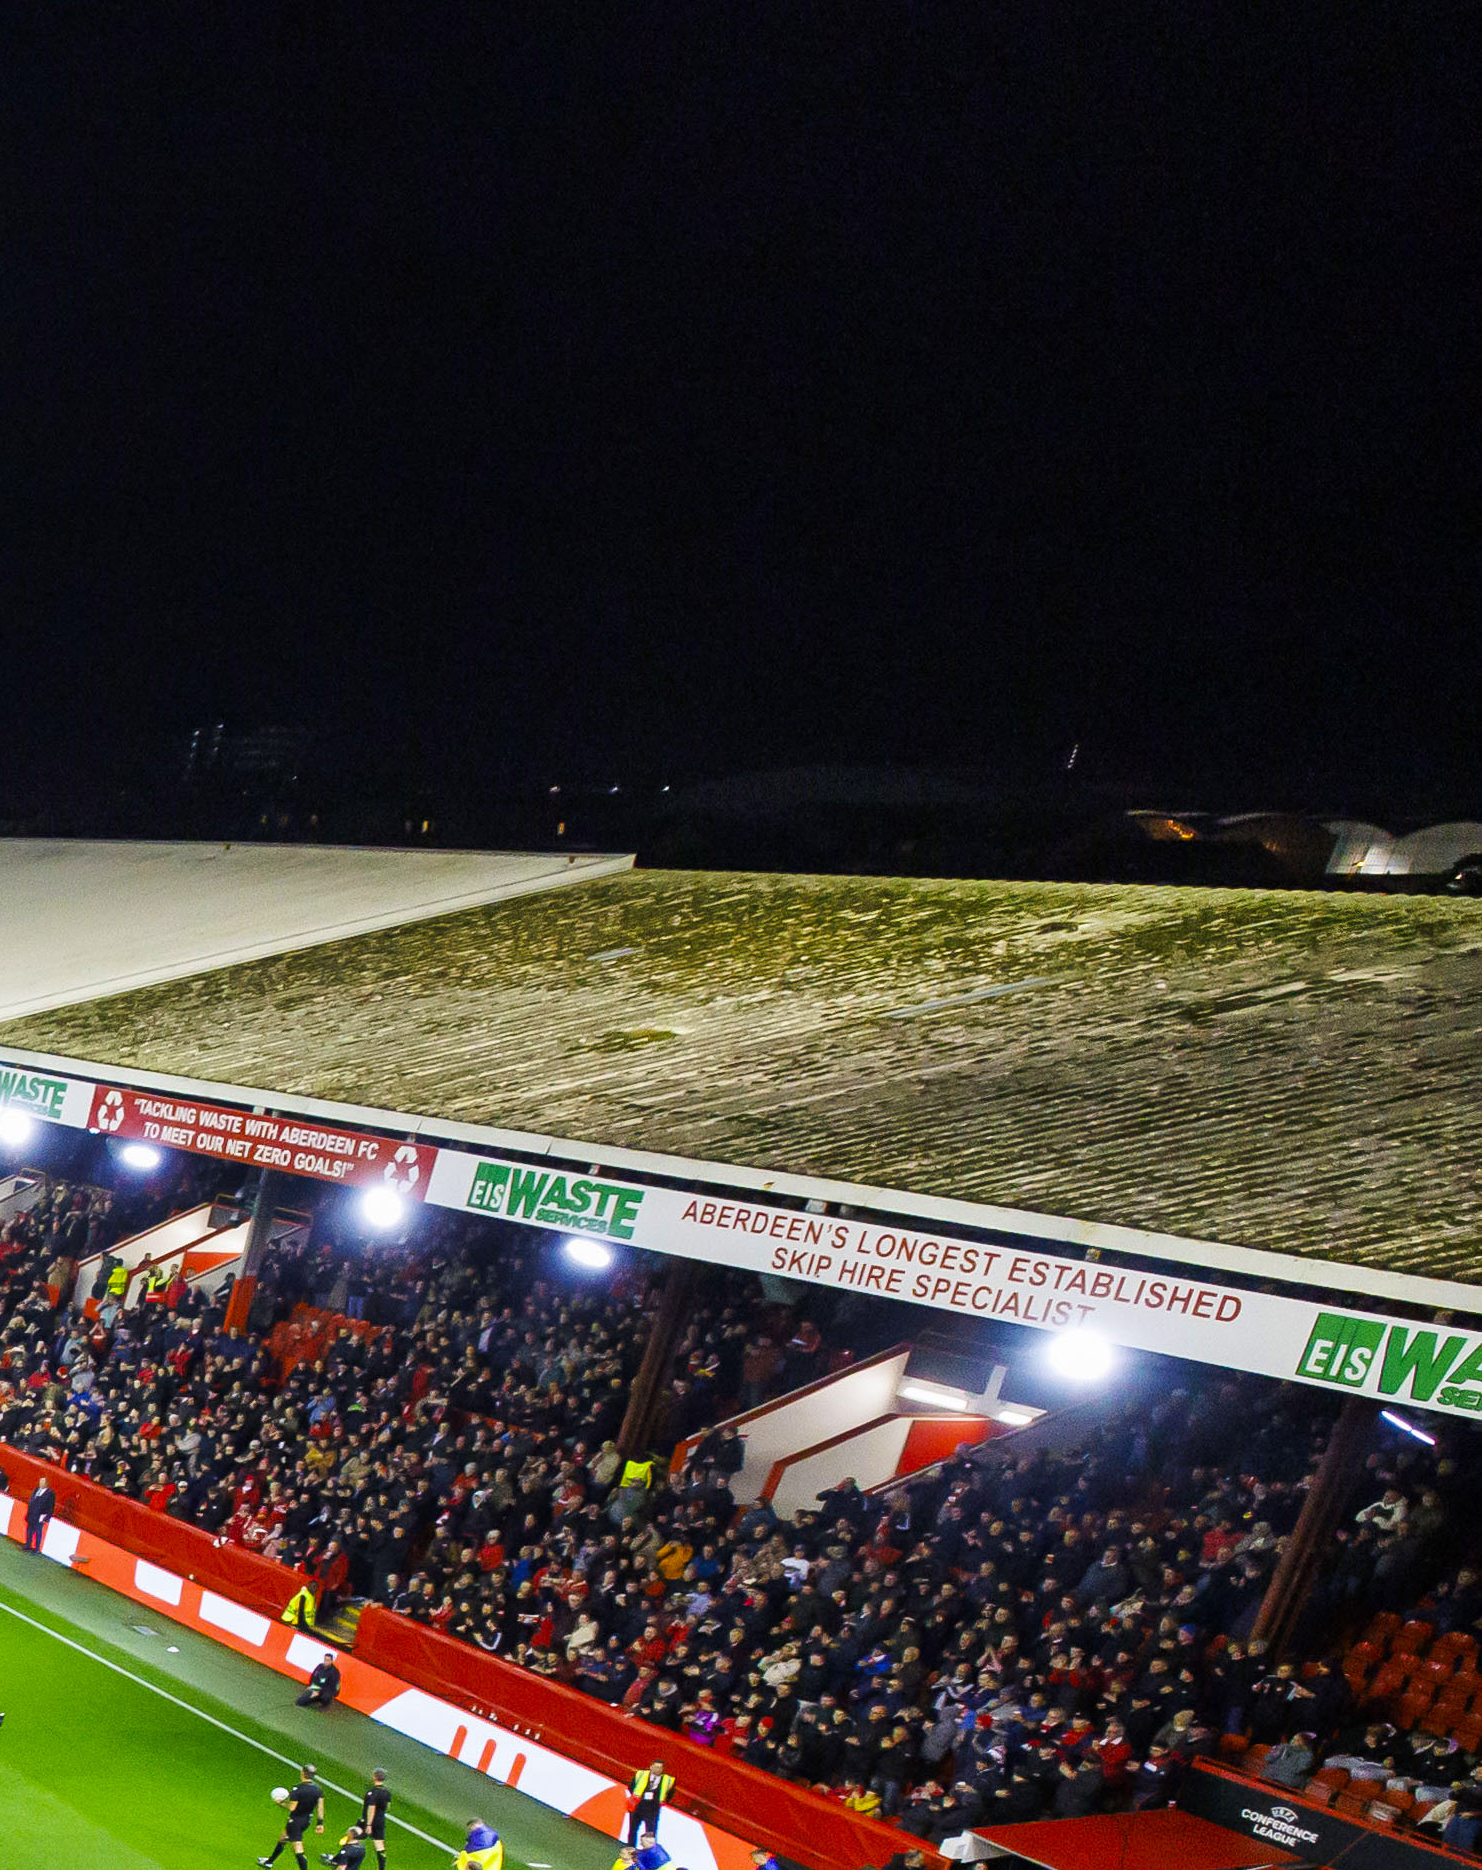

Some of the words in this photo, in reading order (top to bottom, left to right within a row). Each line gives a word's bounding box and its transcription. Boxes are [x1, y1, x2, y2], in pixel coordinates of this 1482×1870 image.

[134, 1097, 197, 1126] "TACKLING
[198, 1109, 245, 1135] WASTE
[244, 1117, 279, 1141] WITH
[279, 1124, 355, 1158] ABERDEEN
[357, 1139, 380, 1161] FC
[143, 1121, 162, 1139] TO
[161, 1124, 196, 1148] MEET
[196, 1132, 224, 1154] OUR
[225, 1137, 253, 1159] NET
[253, 1143, 293, 1168] ZERO
[293, 1150, 355, 1180] GOALS!"
[470, 1178, 507, 1208] EIS
[505, 1167, 645, 1240] WASTE
[536, 1207, 611, 1234] SERVICES
[682, 1199, 849, 1251] ABERDEEN'S
[856, 1229, 1001, 1276] LONGEST
[1007, 1256, 1243, 1323] ESTABLISHED
[771, 1245, 833, 1277] SKIP
[838, 1259, 907, 1294] HIRE
[911, 1273, 1097, 1329] SPECIALIST
[1306, 1341, 1374, 1386] EIS
[1241, 1808, 1319, 1844] CONFERENCE
[1253, 1824, 1298, 1847] LEAGUE
